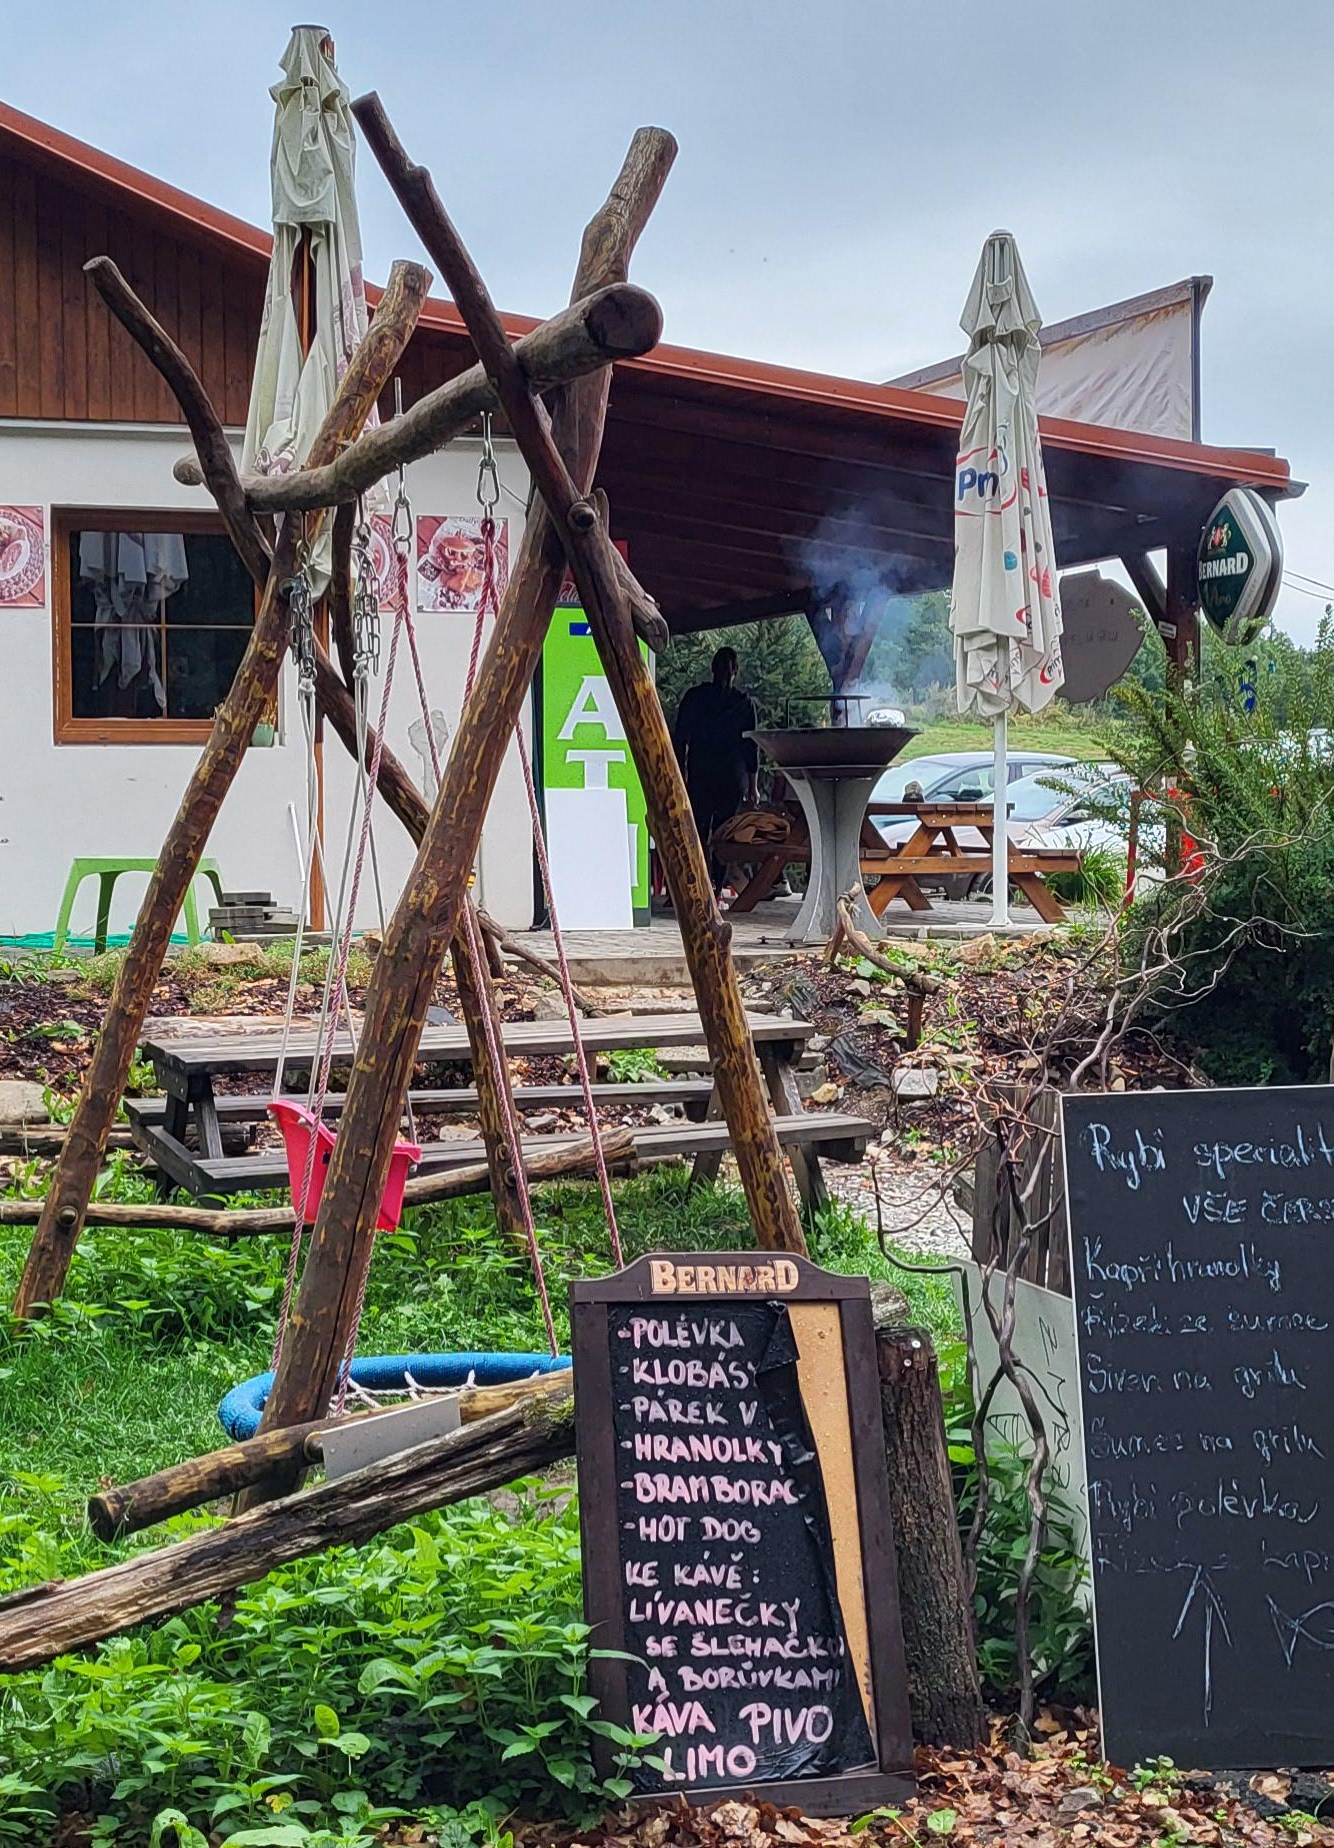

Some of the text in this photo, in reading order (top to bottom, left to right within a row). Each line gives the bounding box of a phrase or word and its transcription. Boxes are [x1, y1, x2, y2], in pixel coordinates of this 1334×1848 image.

[1198, 551, 1250, 582] BERNARD
[1085, 1121, 1167, 1191] Rybí
[1182, 1190, 1248, 1225] VŠE
[649, 1260, 799, 1294] BERNARD
[739, 1400, 758, 1427] V
[700, 1516, 762, 1544] DOG
[625, 1559, 660, 1587] KE
[629, 1590, 801, 1634] LÍVANEČKY
[646, 1635, 678, 1658] SE
[648, 1666, 670, 1693] A
[632, 1690, 834, 1745] KÁVA PIVO
[663, 1743, 757, 1782] LIMO
